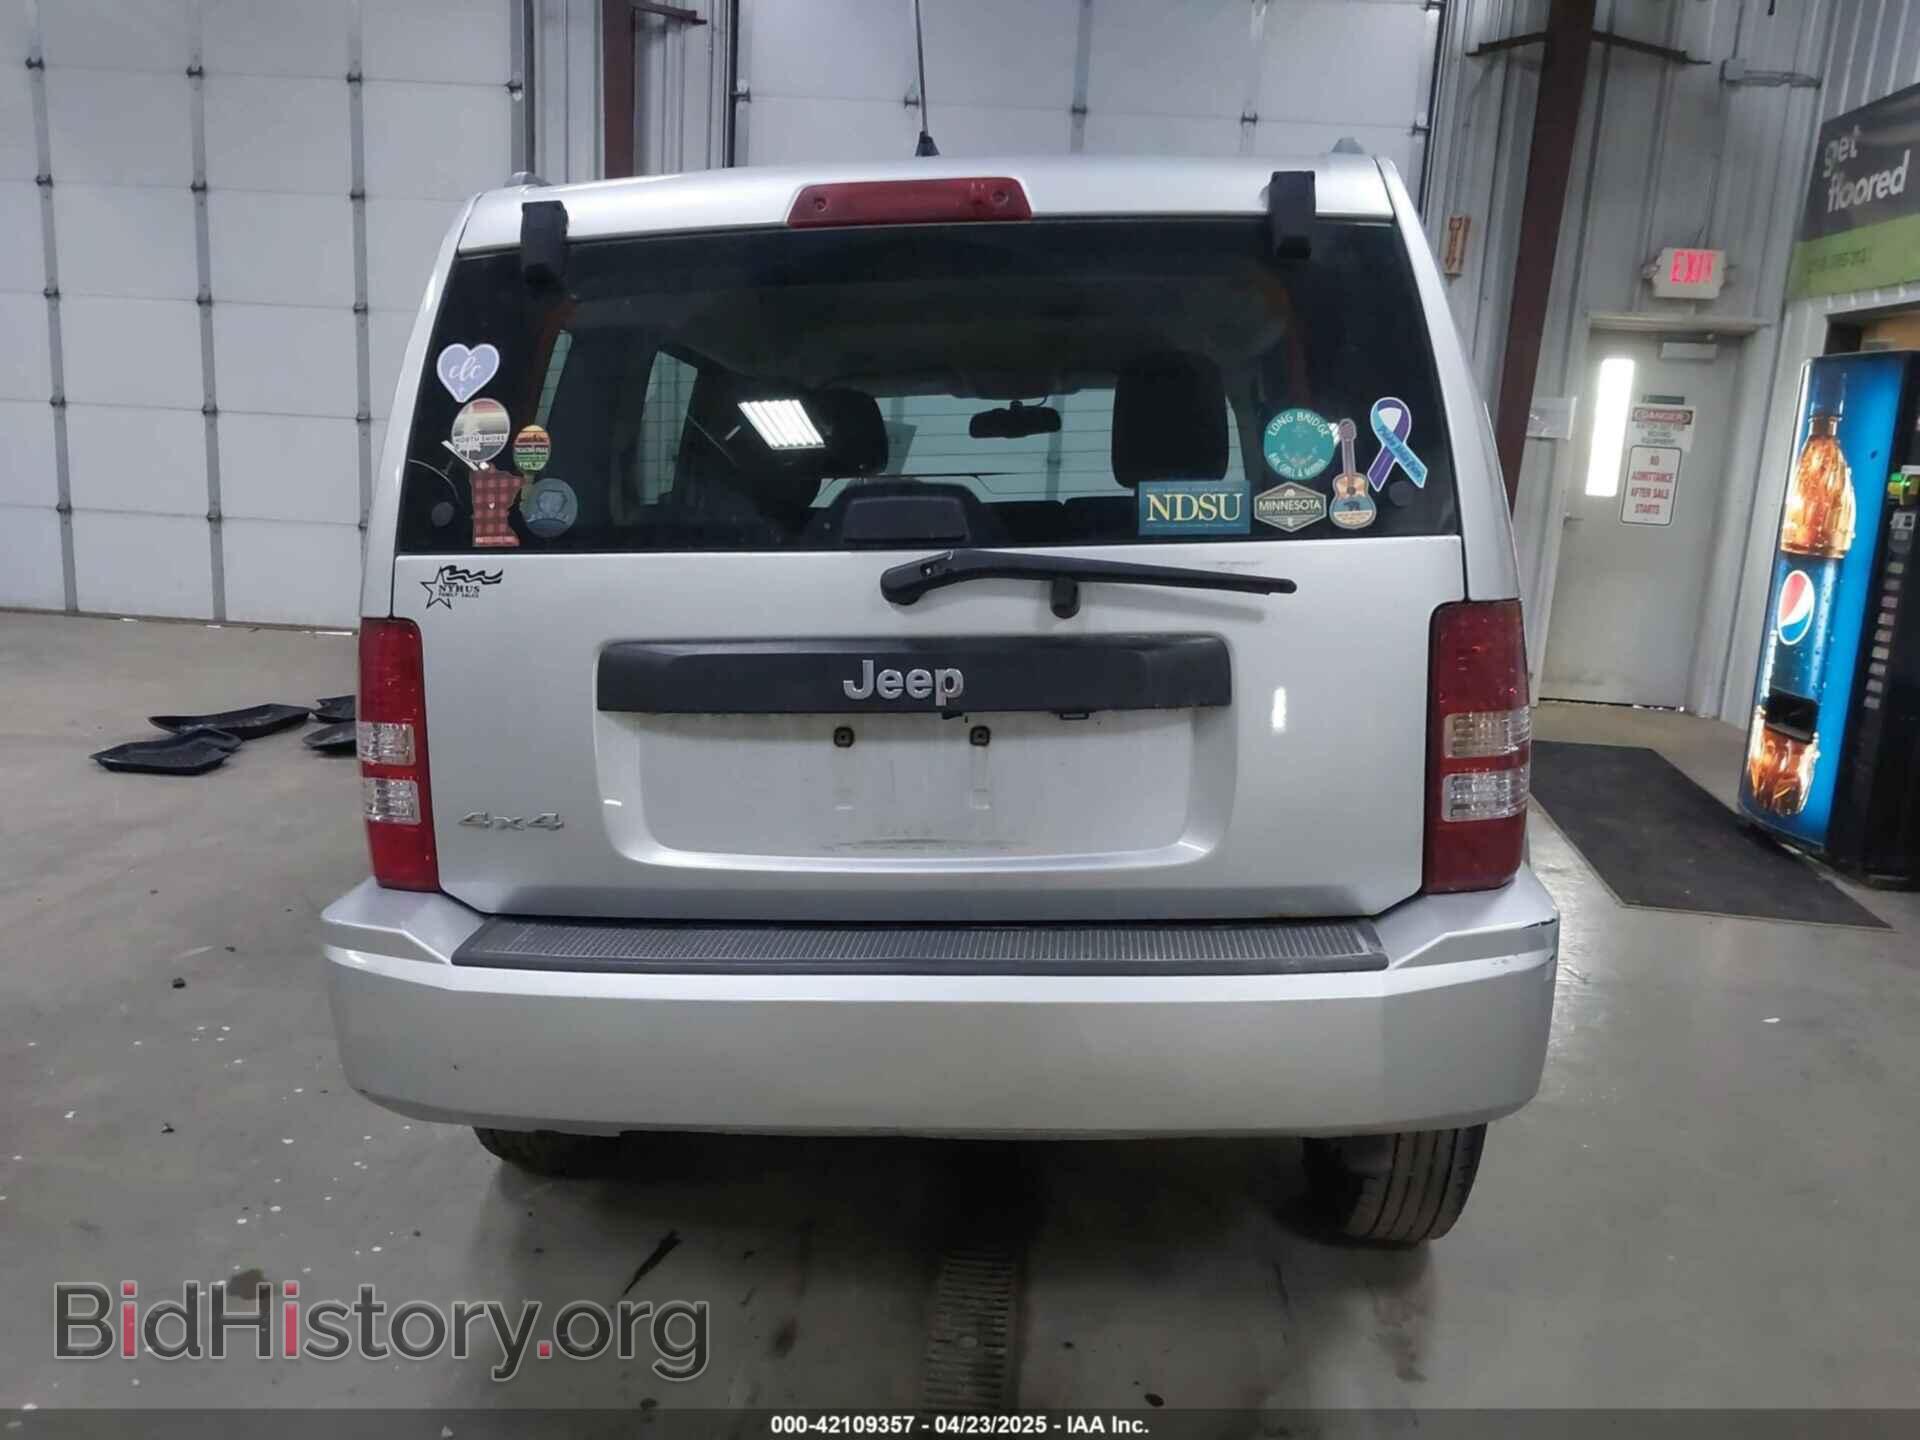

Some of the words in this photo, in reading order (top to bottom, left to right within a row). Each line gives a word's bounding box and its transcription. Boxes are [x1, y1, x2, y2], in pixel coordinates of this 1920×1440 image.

[1823, 125, 1862, 178] get
[1827, 150, 1911, 213] floored
[1669, 250, 1716, 285] EXIT
[1267, 413, 1294, 437] LONG
[1296, 411, 1330, 438] BRIDGE
[1632, 472, 1674, 482] ADMITTANCE
[1146, 493, 1243, 521] NDSU
[1258, 499, 1322, 512] MINNESOTA
[1634, 503, 1661, 515] STARTS
[843, 659, 965, 707] Jeep
[458, 811, 565, 832] 4x4
